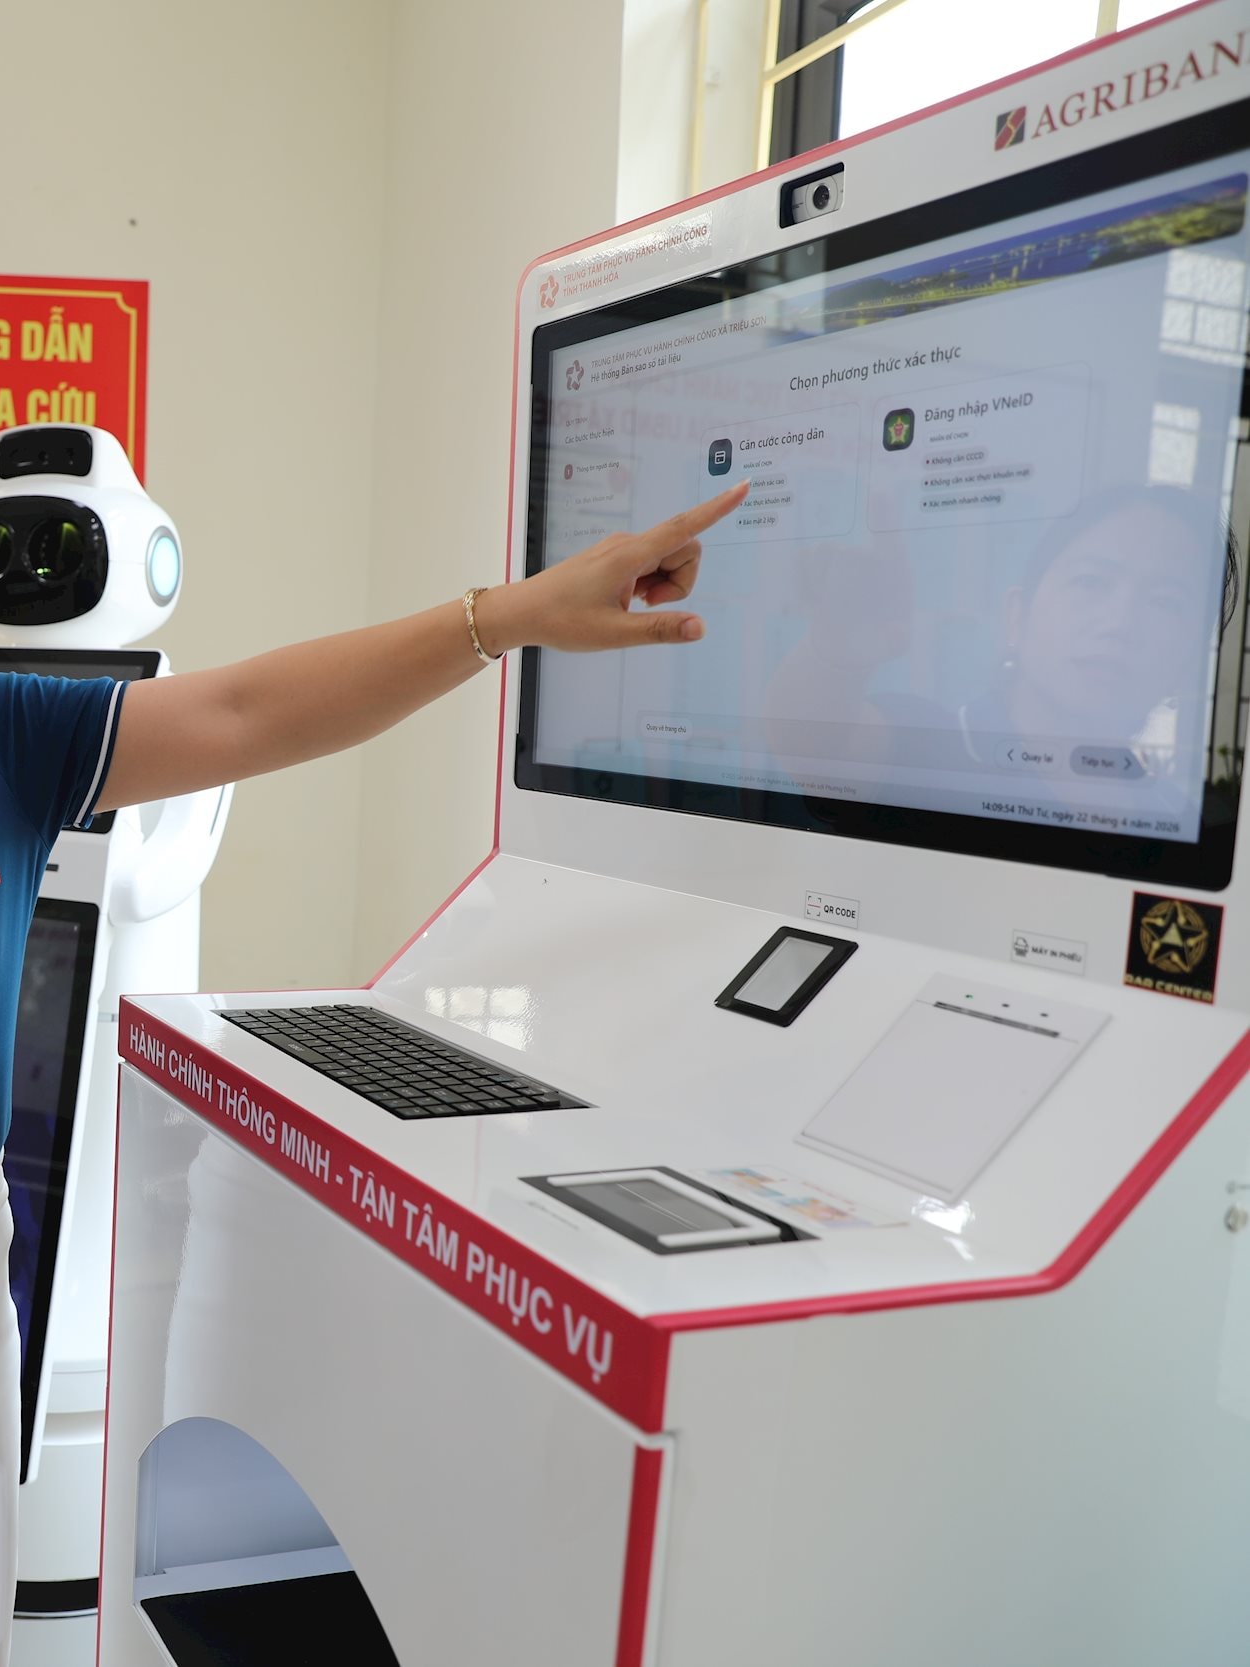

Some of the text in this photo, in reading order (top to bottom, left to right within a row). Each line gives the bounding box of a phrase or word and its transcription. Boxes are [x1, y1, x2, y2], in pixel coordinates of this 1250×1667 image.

[1031, 30, 1250, 139] AGRIBAN
[563, 225, 707, 285] TRUNG TÂM PHỤC VỤ HÀNH CHÍNH CÔNG
[579, 276, 603, 292] THANH
[21, 306, 94, 363] DẪN
[591, 355, 612, 369] TRUNG
[612, 351, 625, 364] TÂM
[625, 347, 643, 361] PHỤC
[653, 338, 673, 352] HÀNH
[673, 333, 695, 347] CHÍNH
[696, 328, 717, 341] CÔNG
[717, 323, 728, 336] XÃ
[729, 318, 749, 334] TRIỆU
[750, 315, 767, 329] SƠN
[601, 366, 620, 381] thống
[635, 362, 647, 373] sao
[668, 351, 681, 365] liệu
[789, 375, 819, 391] Chọn
[821, 363, 868, 387] phương
[872, 355, 901, 375] thức
[904, 352, 926, 369] xác
[930, 345, 961, 365] thực
[26, 382, 97, 426] CỨU
[924, 392, 1034, 422] Đăng nhập VNeID
[589, 430, 602, 440] thực
[602, 427, 614, 438] hiện
[739, 427, 825, 451] Căn cước công dân
[931, 456, 952, 466] Không
[965, 451, 985, 461] CCCD
[930, 477, 950, 487] Không
[1021, 751, 1041, 764] Quay
[981, 801, 1015, 814] 14:09:54
[1017, 804, 1034, 817] Thứ
[1052, 810, 1074, 824] ngày
[1076, 811, 1088, 823] 22
[1090, 812, 1118, 828] tháng
[1129, 818, 1153, 829] năm
[823, 904, 857, 919] QR CODE
[1155, 980, 1213, 1002] CENTER
[129, 1022, 166, 1073] HÀNH
[168, 1047, 213, 1104] CHÍNH
[217, 1076, 277, 1147] THÔNG
[280, 1121, 331, 1185] MINH
[349, 1164, 396, 1229] TẬN
[402, 1199, 459, 1273] TÂM
[465, 1238, 554, 1337] PHỤC
[562, 1303, 614, 1383] VỤ
